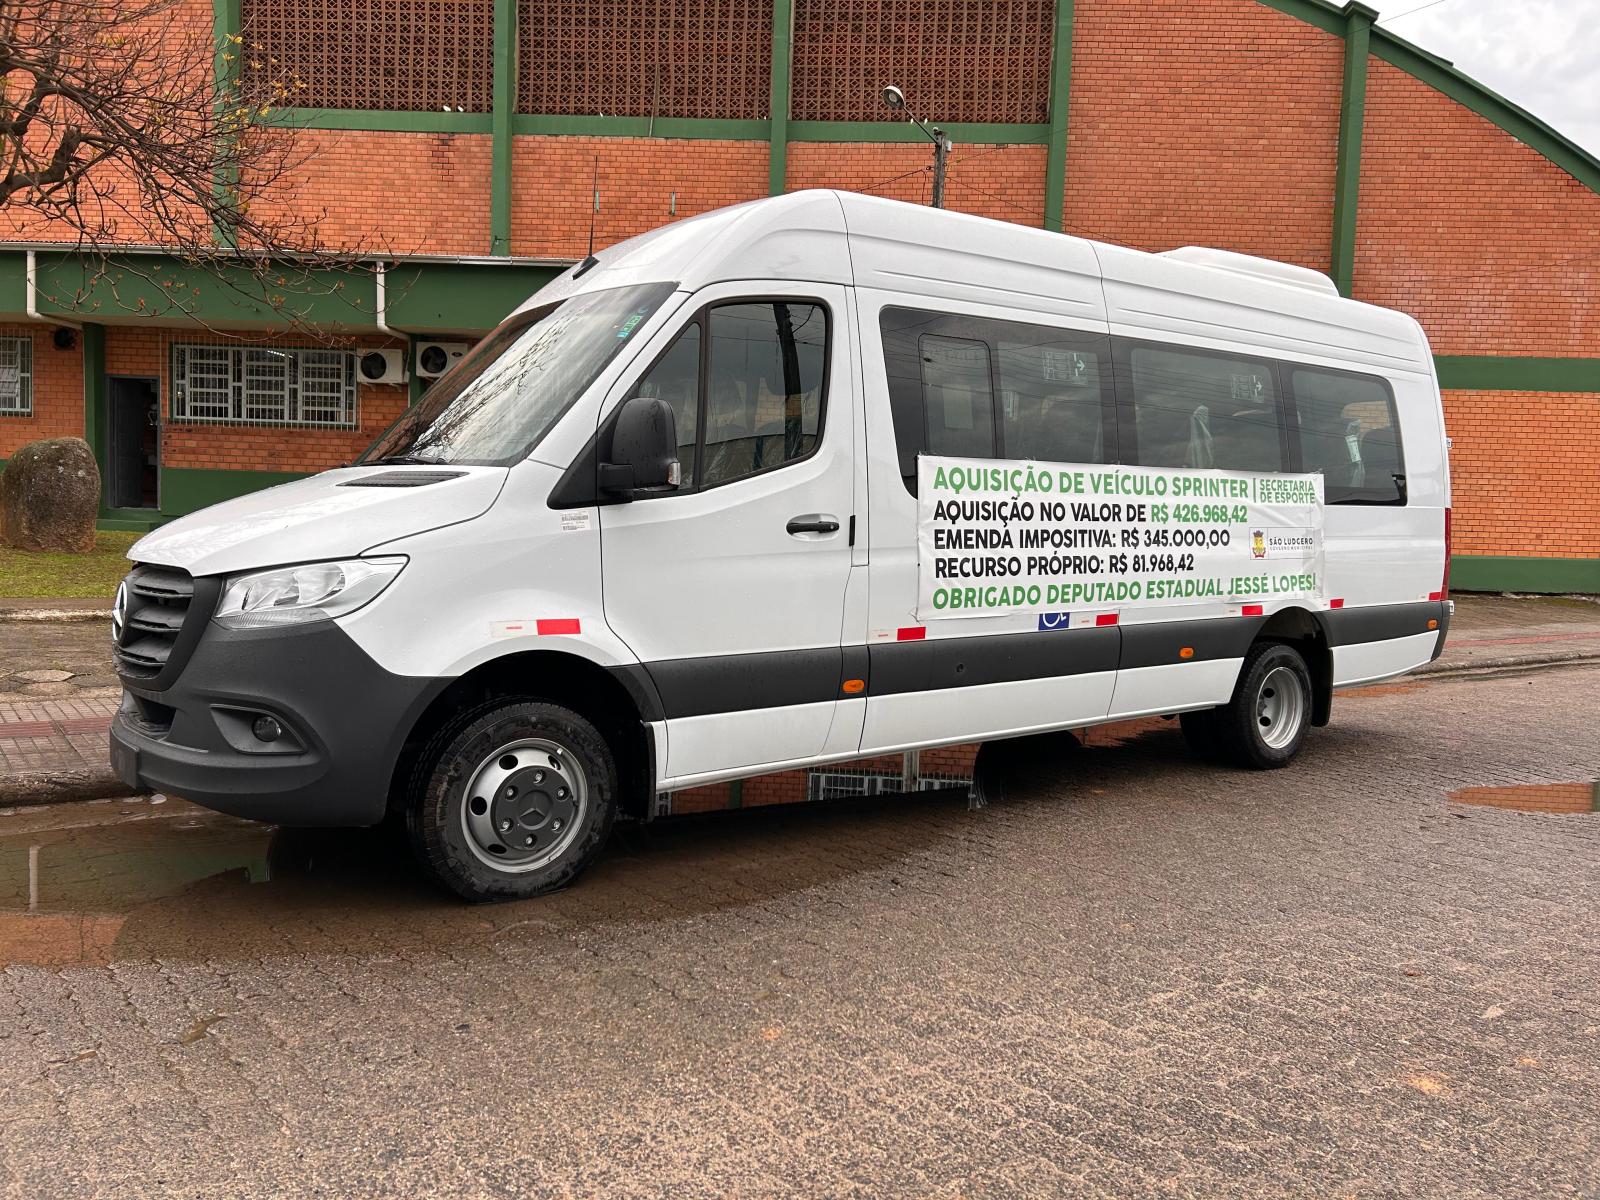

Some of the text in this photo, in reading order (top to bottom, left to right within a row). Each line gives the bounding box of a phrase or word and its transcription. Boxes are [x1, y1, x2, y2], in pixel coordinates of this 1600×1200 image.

[933, 465, 1249, 498] AQUISIÇÃO DE VEÍCULO SPRINTER
[1260, 479, 1315, 491] SECRETARIA
[1260, 491, 1316, 504] DE ESPORTE
[933, 496, 1248, 528] AQUISIÇÃO NO VALOR DE R$ 426.968,42
[934, 528, 1230, 550] EMENDA IMPOSITIVA: R$ 345.000,00
[1269, 537, 1282, 546] SÃO
[935, 551, 1194, 579] RECURSO PRÓPRIO: R$ 81.968,42
[932, 573, 1316, 610] OBRIGADO DEPUTADO ESTADUAL JESSÉ LOPES!
